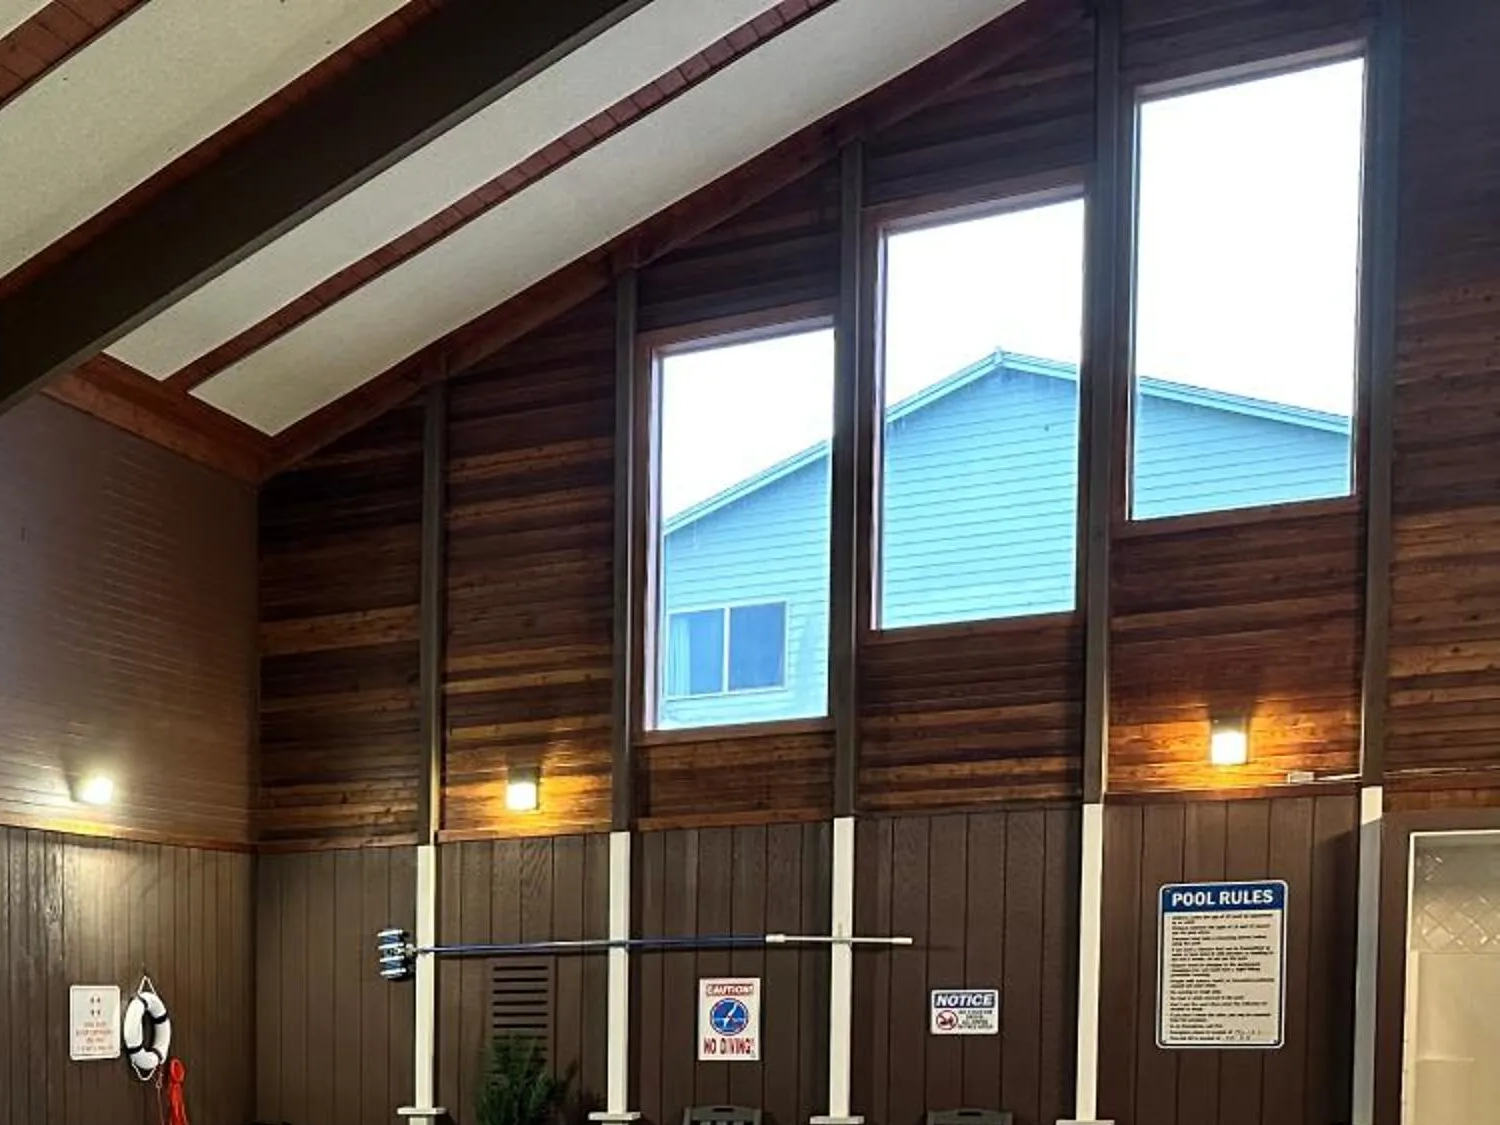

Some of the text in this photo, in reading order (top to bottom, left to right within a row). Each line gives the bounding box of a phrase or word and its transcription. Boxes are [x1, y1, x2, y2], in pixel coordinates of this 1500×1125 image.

[1171, 889, 1274, 907] POOL RULES
[936, 993, 993, 1007] NOTICE
[704, 1037, 716, 1054] NO
